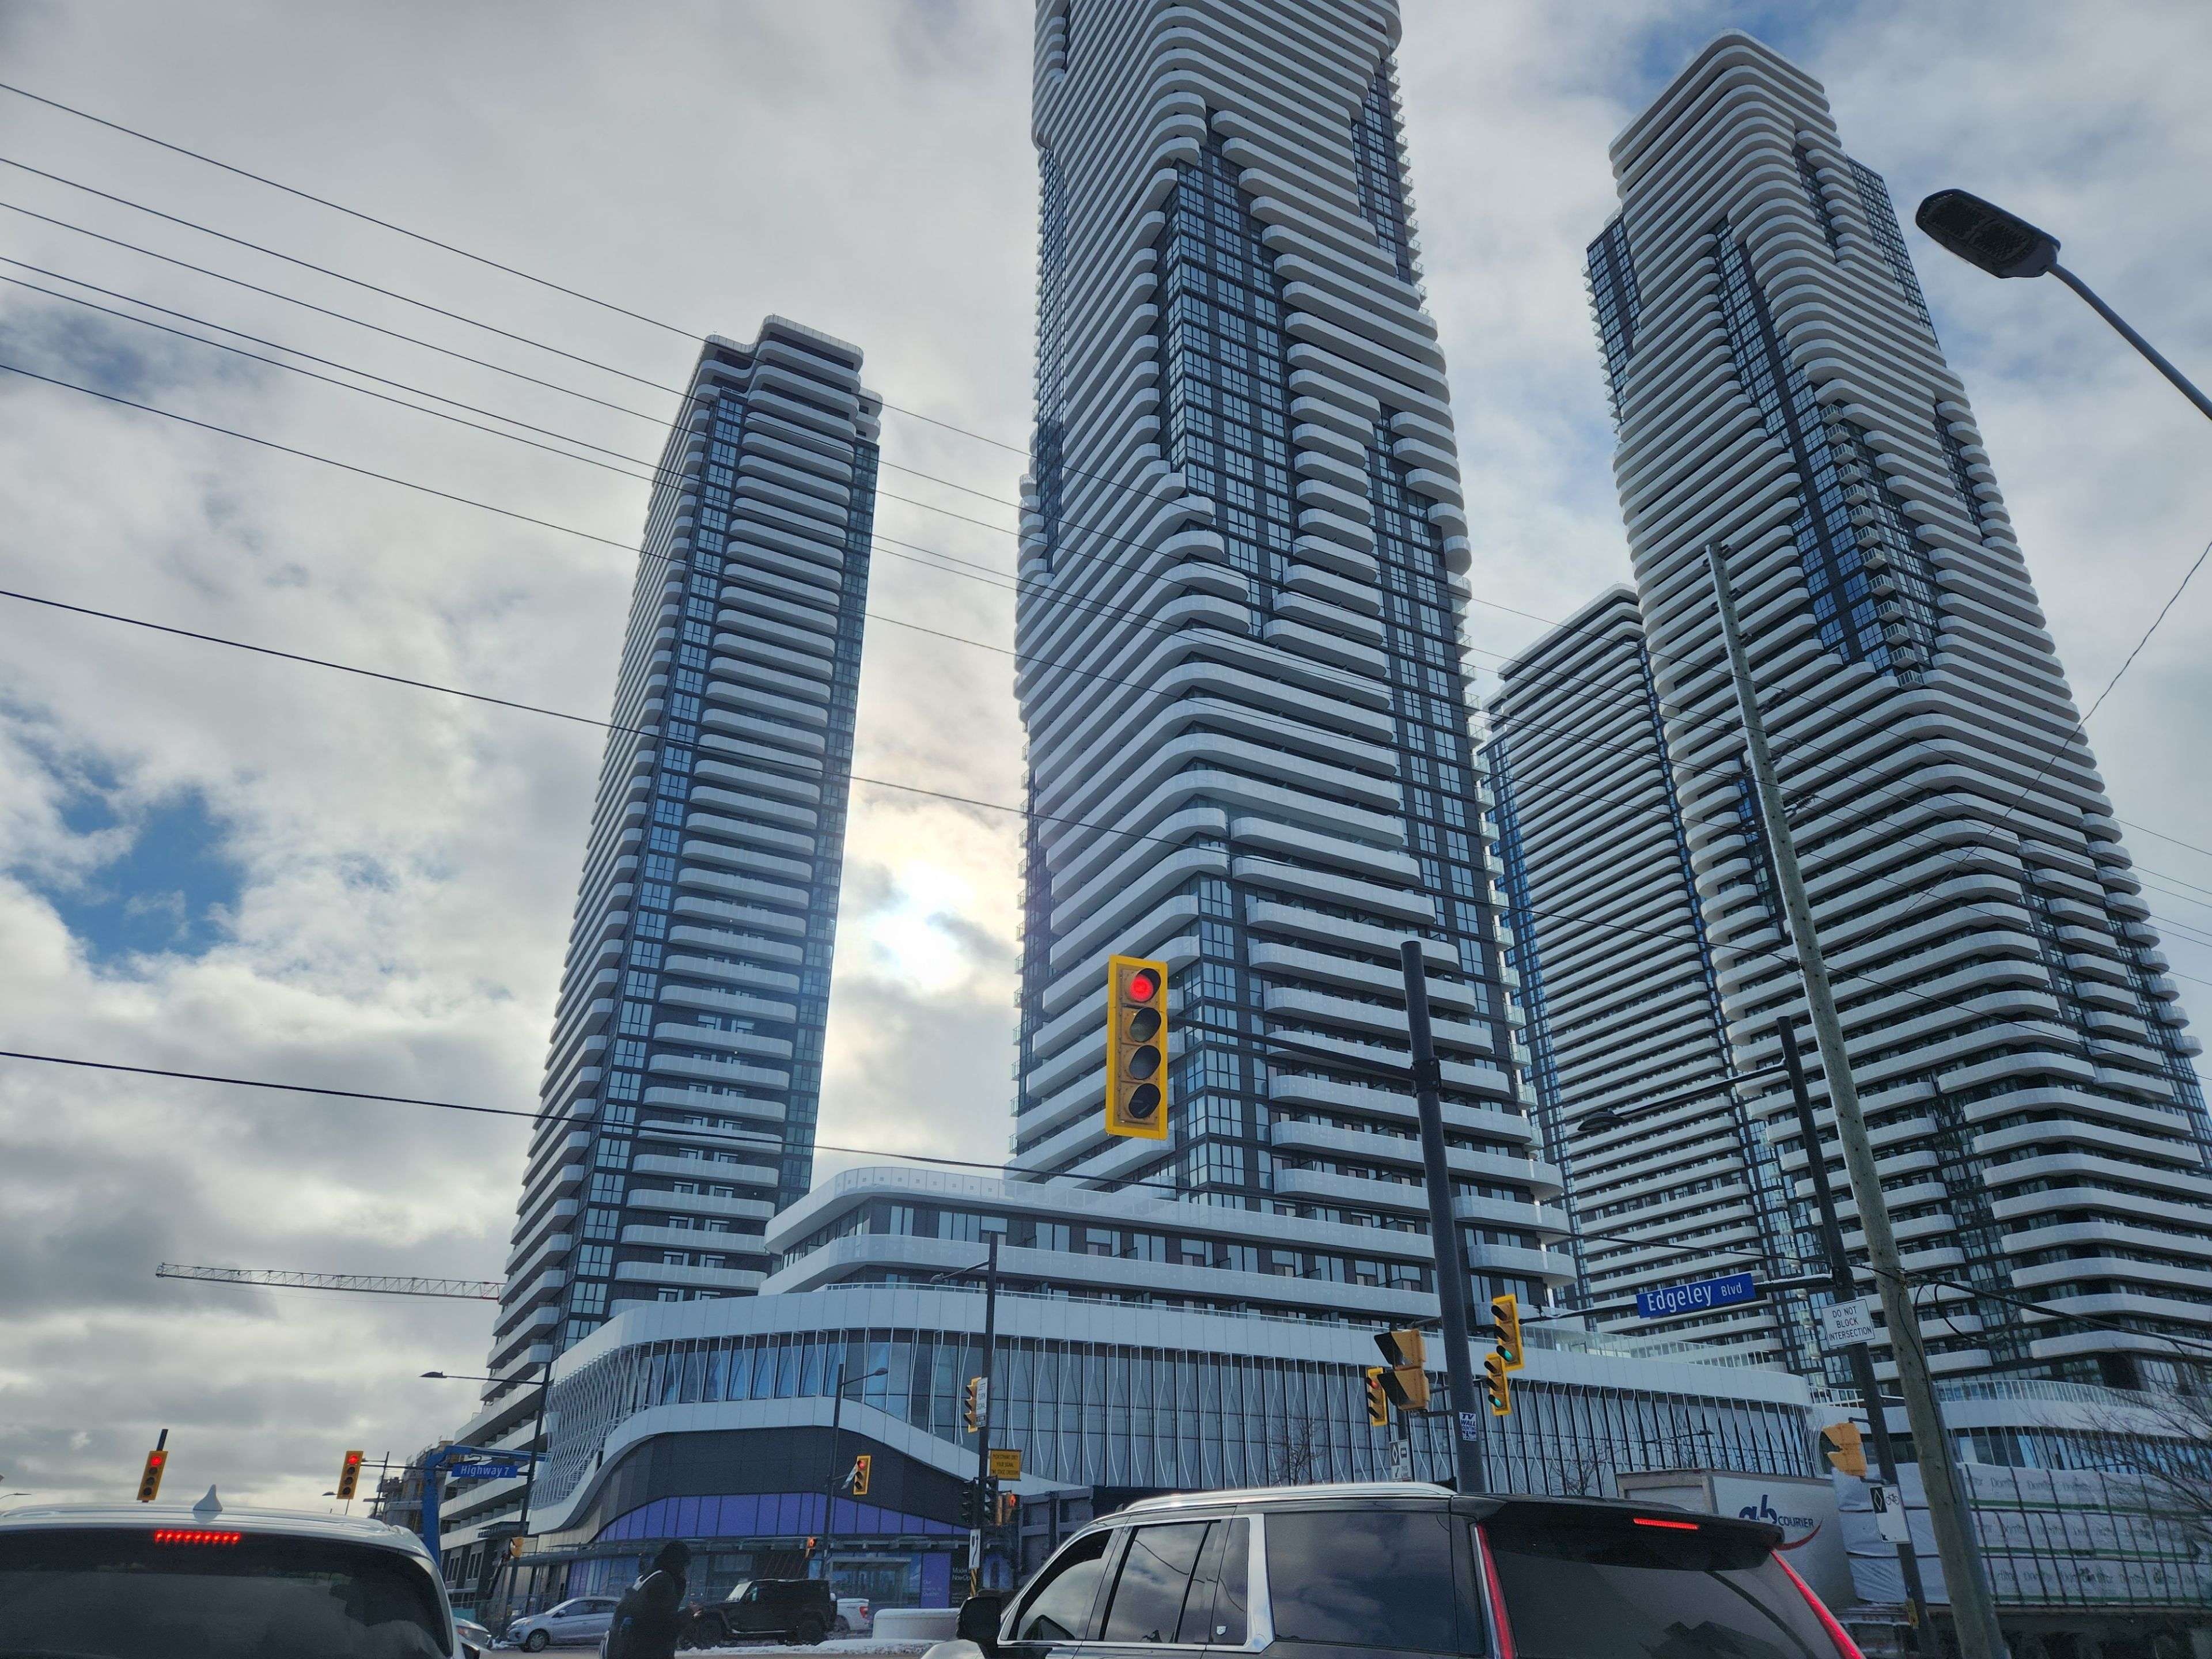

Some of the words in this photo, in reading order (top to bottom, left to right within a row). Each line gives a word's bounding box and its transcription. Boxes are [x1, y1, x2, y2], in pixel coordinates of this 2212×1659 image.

[1647, 1285, 1711, 1313] Edgeley
[1721, 1282, 1743, 1296] Blvd
[1832, 1309, 1842, 1318] DO
[1844, 1306, 1857, 1316] NOT
[1836, 1317, 1858, 1328] BLOCK
[1828, 1326, 1872, 1342] INTERSECTION
[461, 1465, 502, 1477] Highway
[504, 1467, 510, 1475] 7
[1778, 1516, 1815, 1528] COURIER
